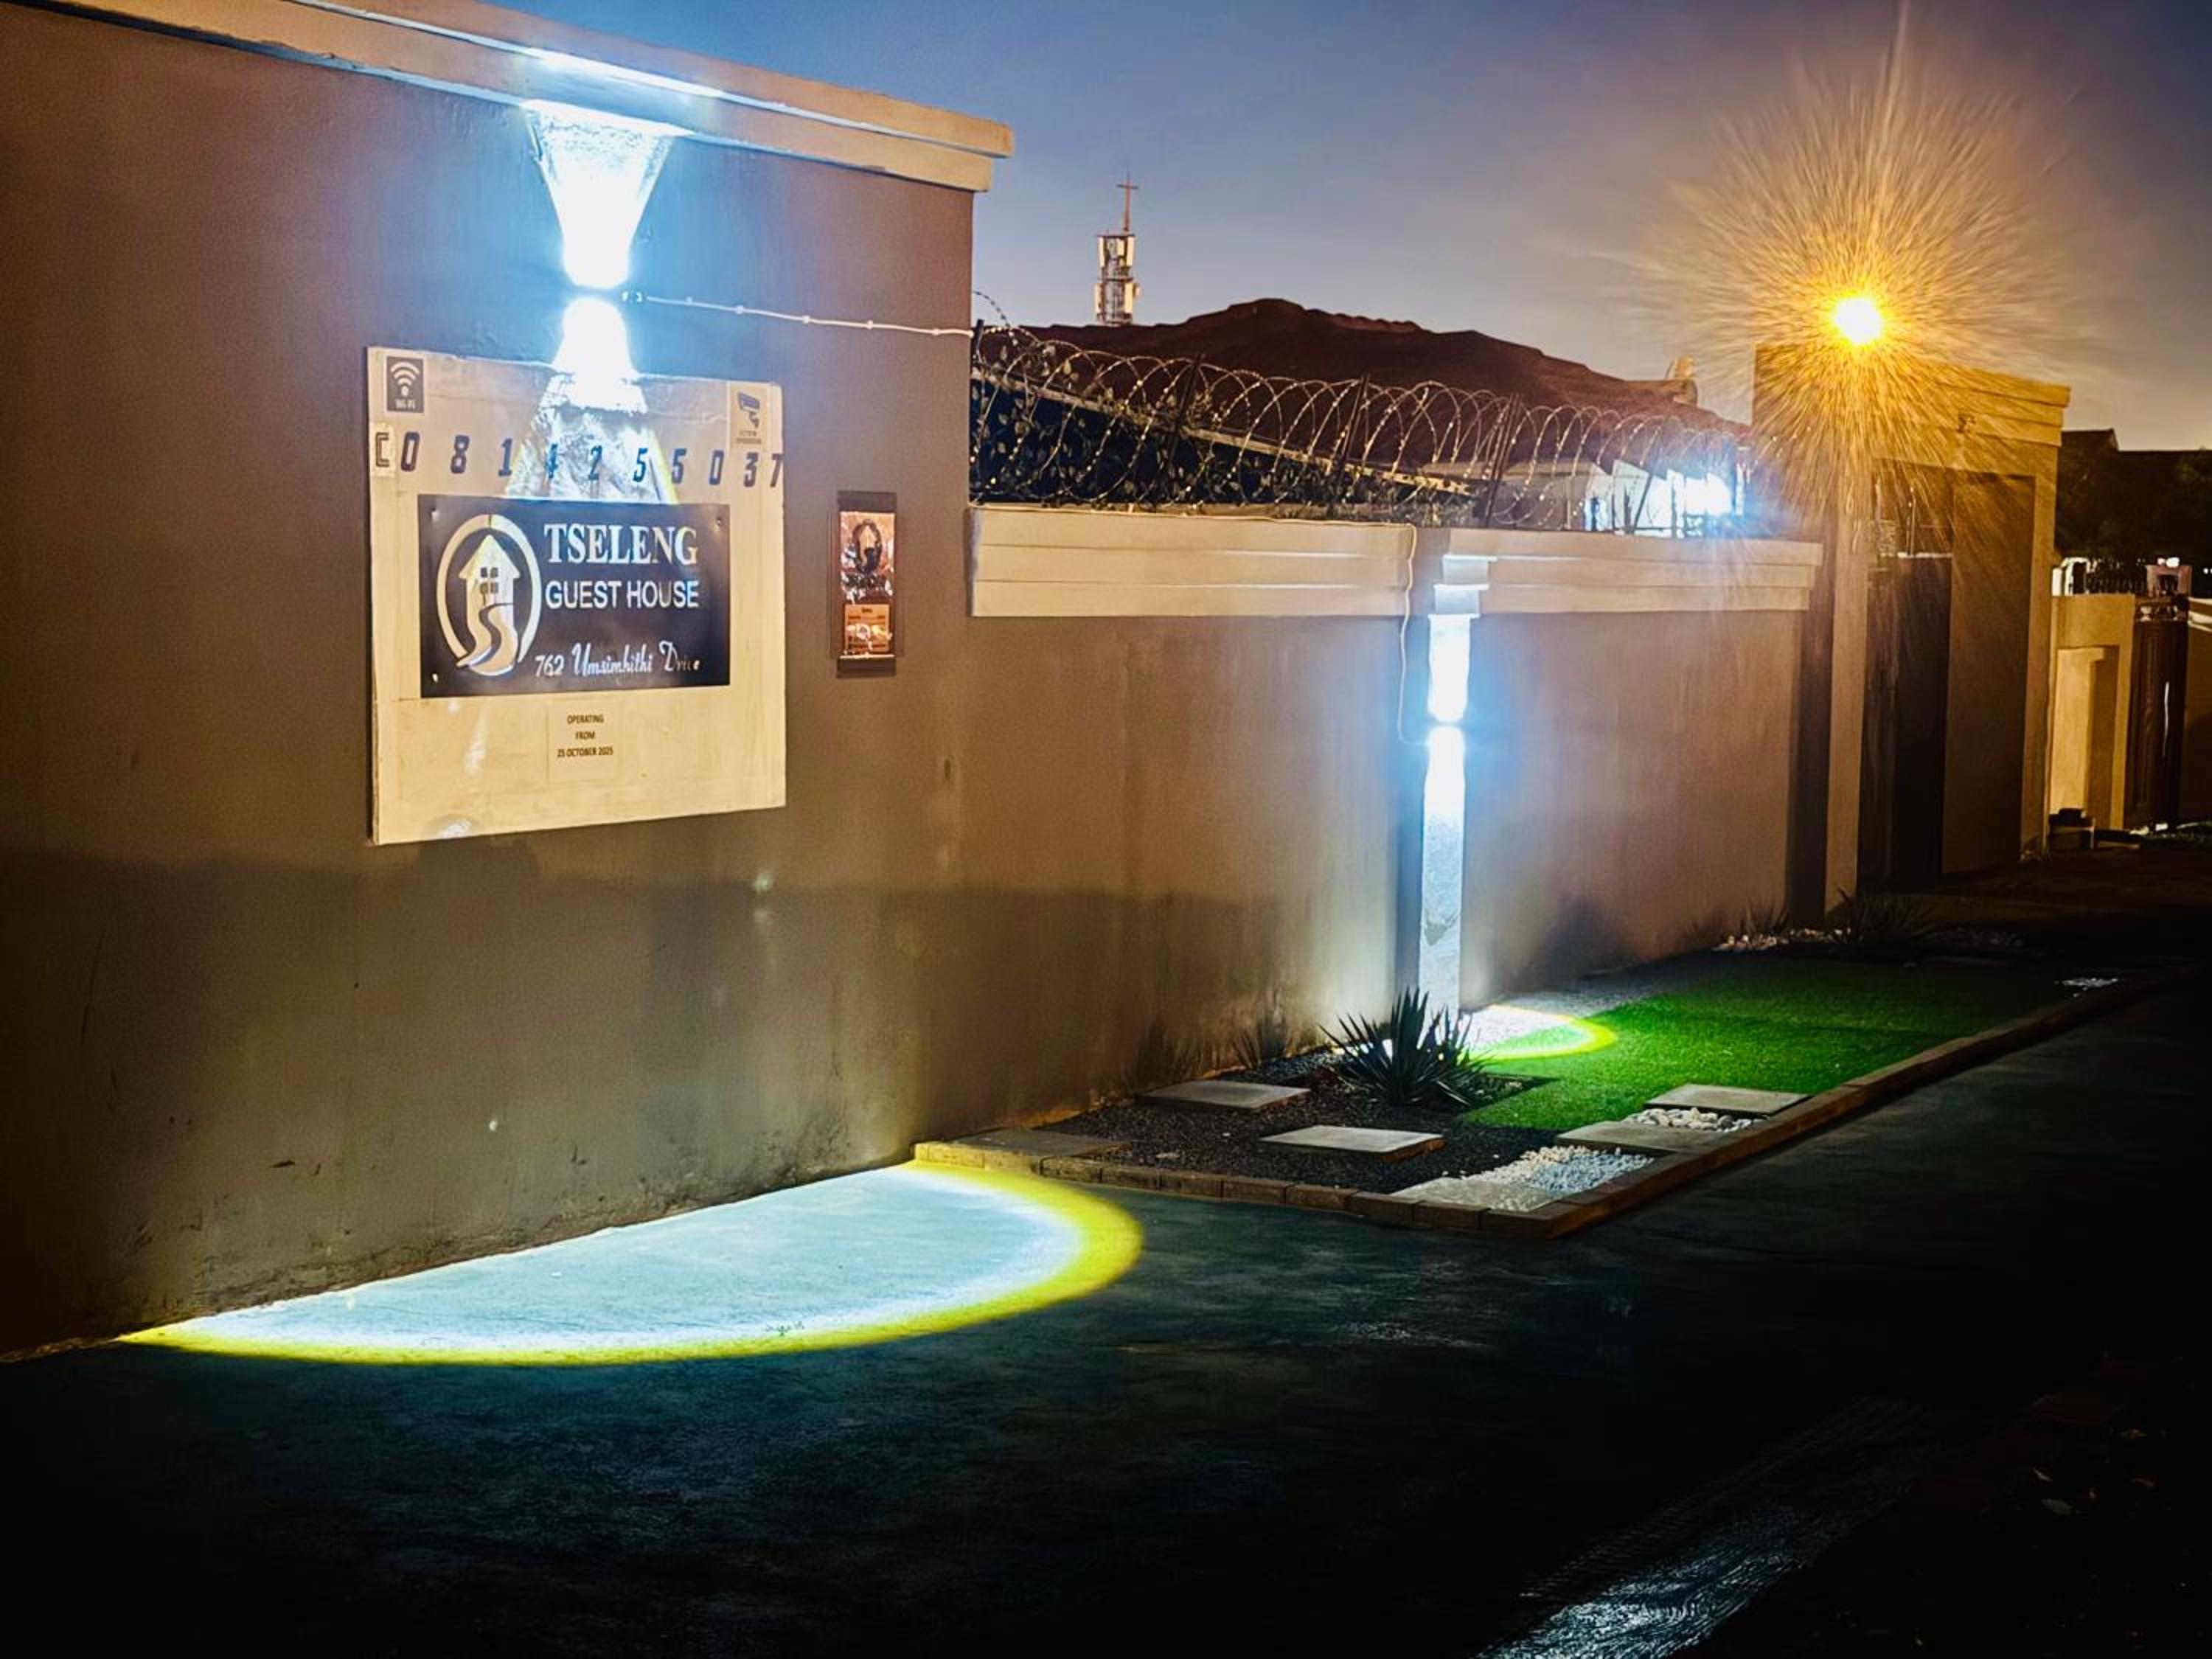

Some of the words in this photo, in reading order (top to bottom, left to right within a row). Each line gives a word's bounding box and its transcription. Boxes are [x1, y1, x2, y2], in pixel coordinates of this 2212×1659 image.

[543, 523, 698, 565] TSELENG
[545, 580, 622, 609] GUEST
[627, 580, 700, 608] HOUSE
[535, 654, 565, 678] 762
[567, 714, 604, 724] OPERATING
[576, 731, 596, 740] FROM
[566, 747, 597, 757] OCTOBER
